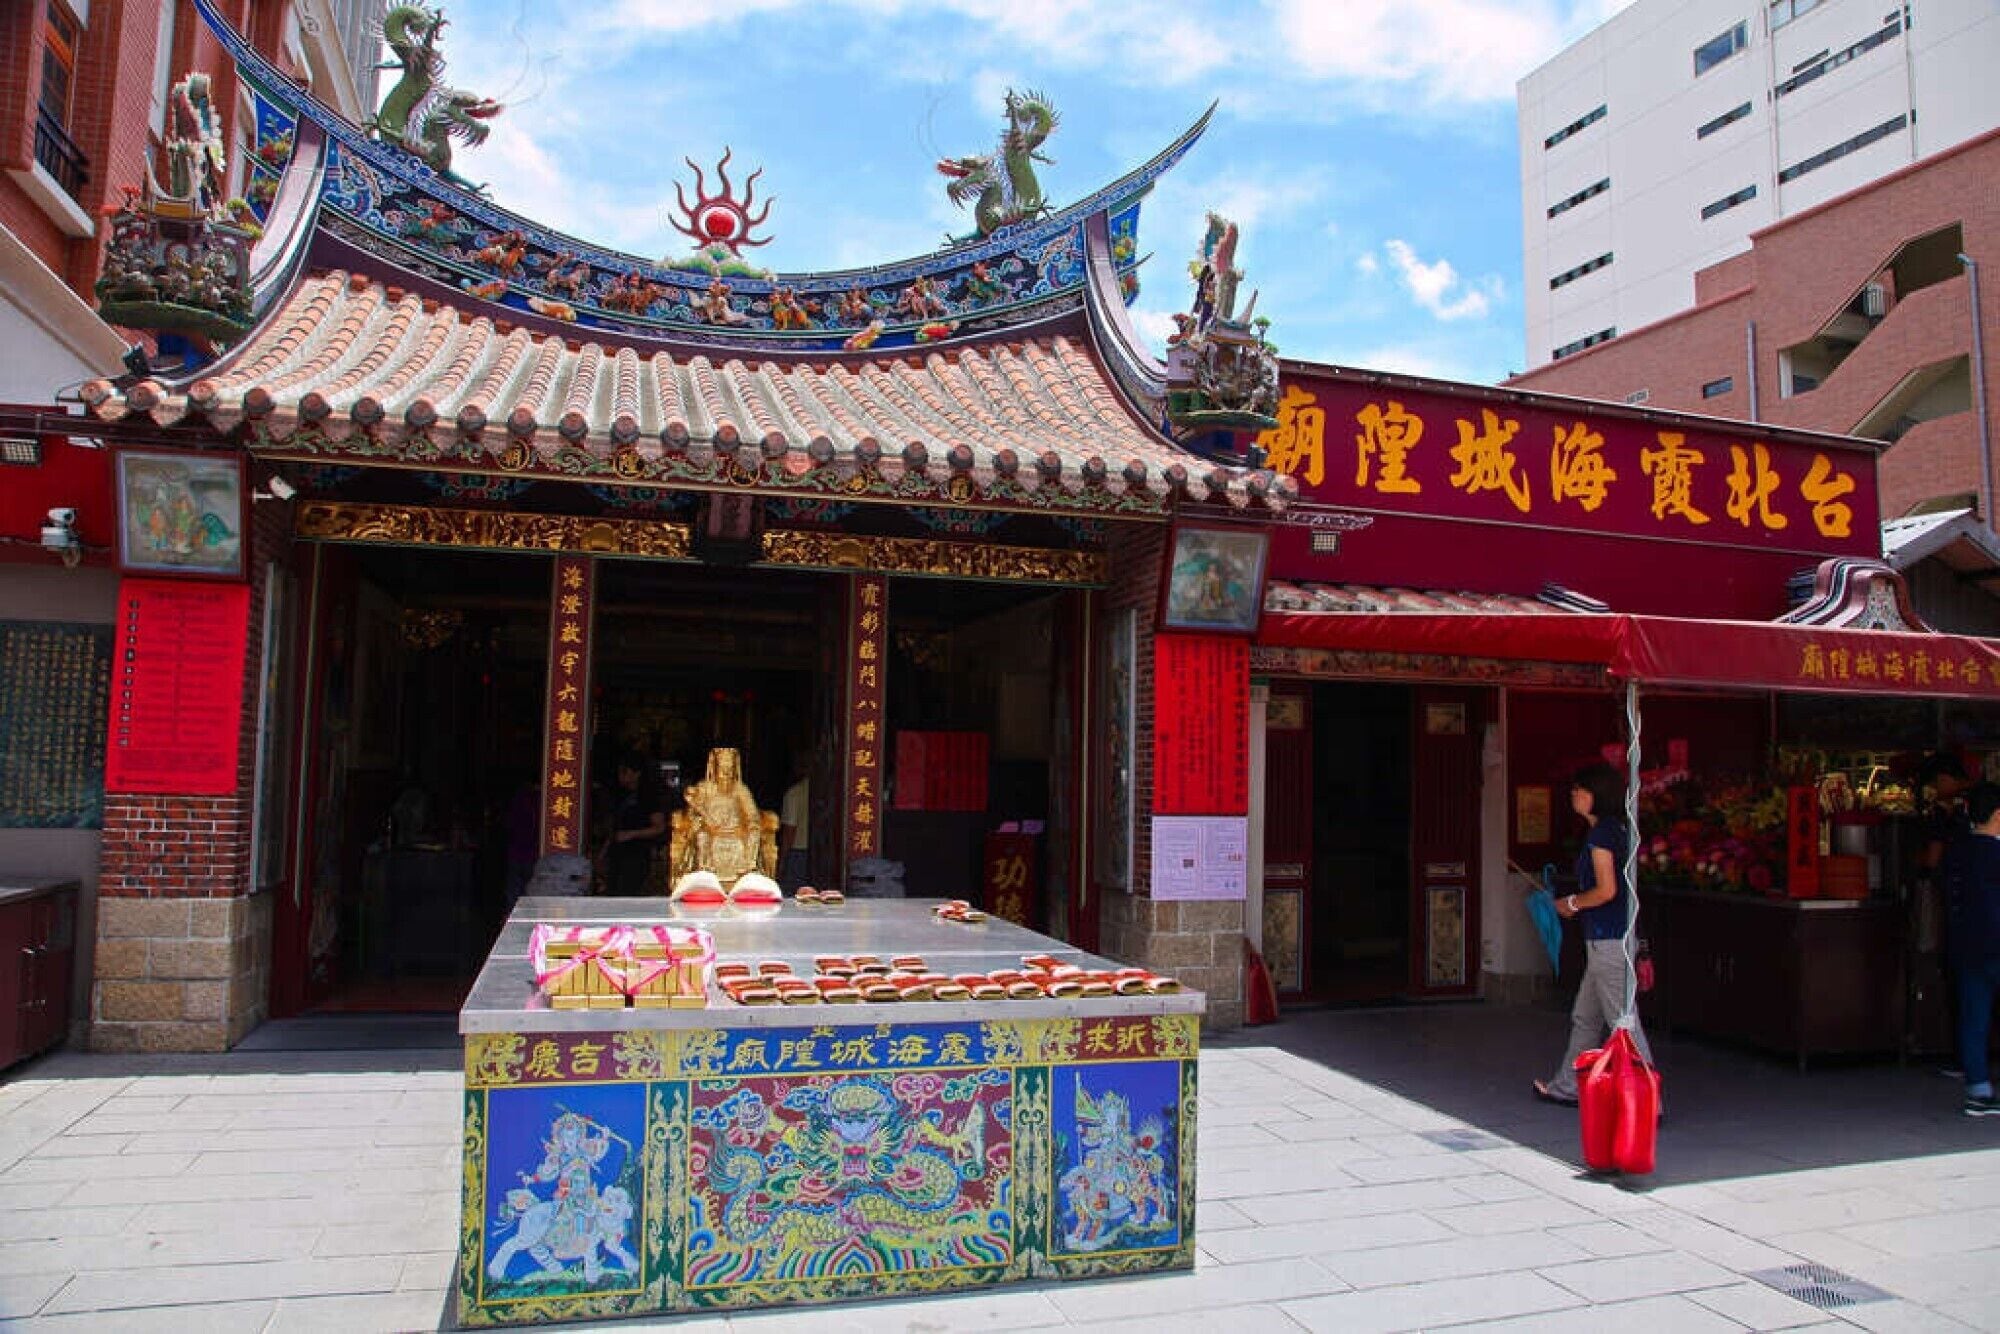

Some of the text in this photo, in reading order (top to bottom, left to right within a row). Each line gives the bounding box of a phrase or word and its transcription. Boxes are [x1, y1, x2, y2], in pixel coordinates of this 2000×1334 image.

[1257, 385, 1856, 539] 台北霞海城隍廟
[1085, 1020, 1147, 1056] 祈求
